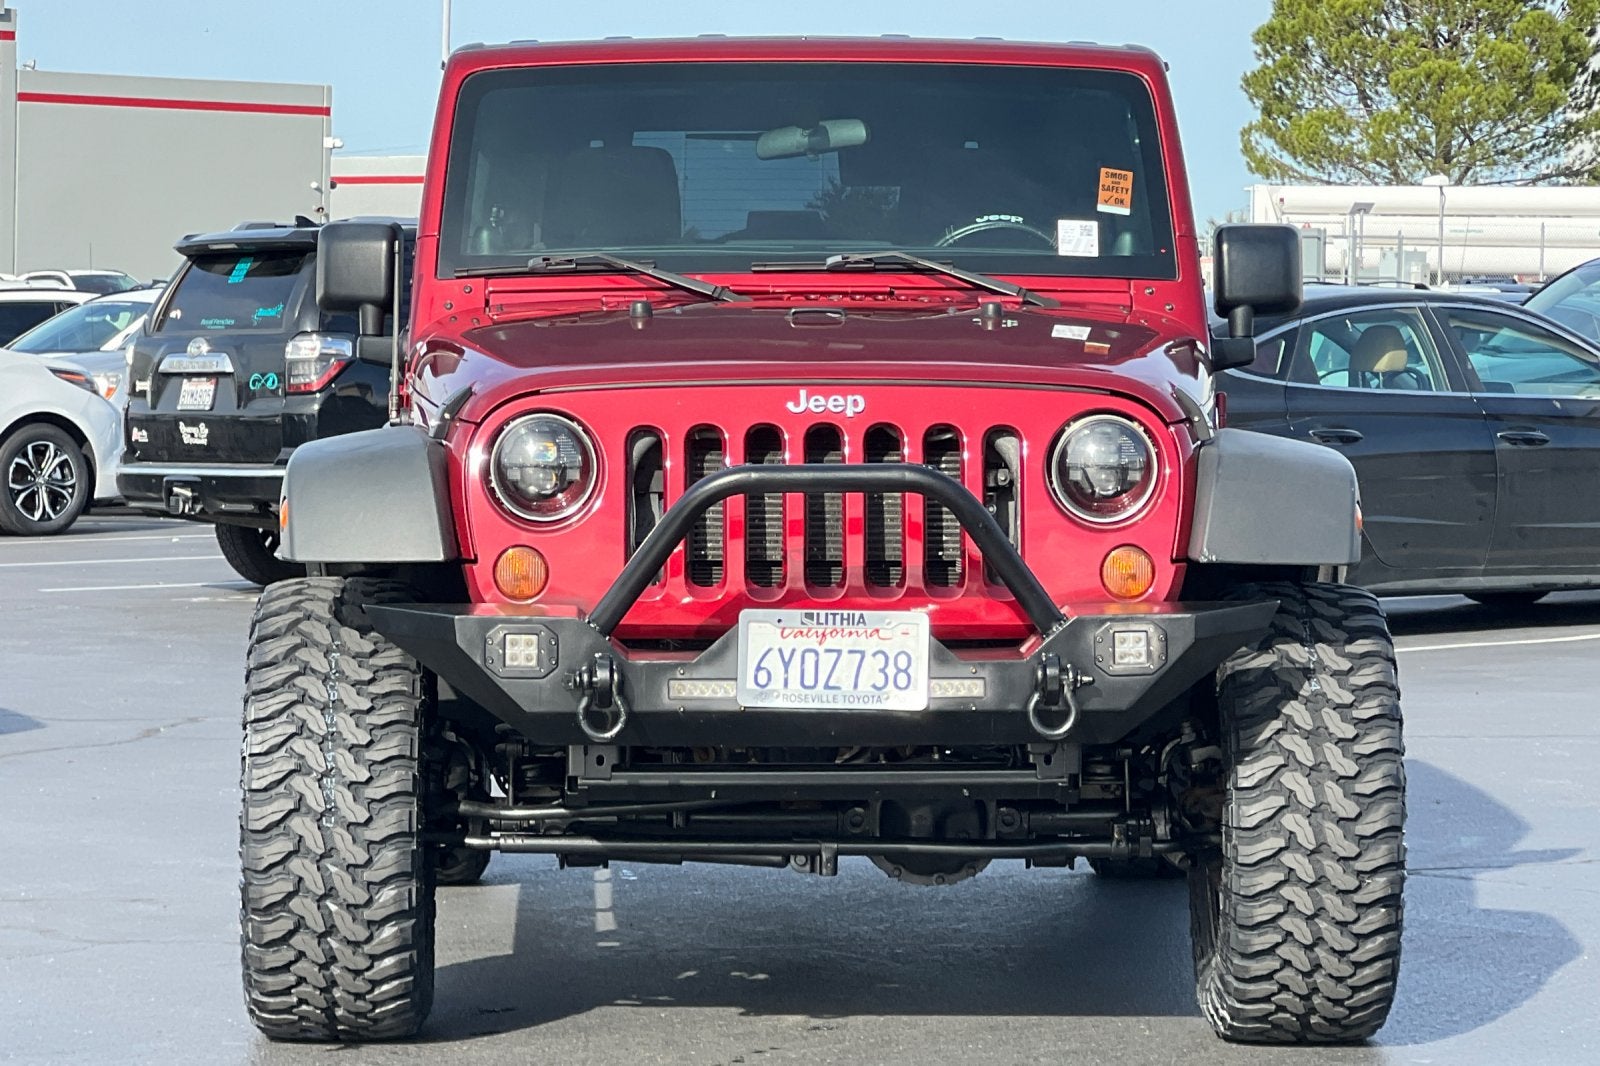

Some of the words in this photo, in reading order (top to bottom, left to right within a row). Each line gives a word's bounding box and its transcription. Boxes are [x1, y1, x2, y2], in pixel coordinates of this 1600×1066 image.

[1105, 171, 1128, 181] SMOG
[1101, 184, 1130, 195] SAFETY
[1114, 197, 1125, 206] OK
[786, 389, 866, 418] Jeep
[816, 612, 867, 627] LITHIA
[780, 626, 893, 646] California
[782, 693, 839, 704] ROSEVILLE
[842, 694, 883, 705] TOYOTA
